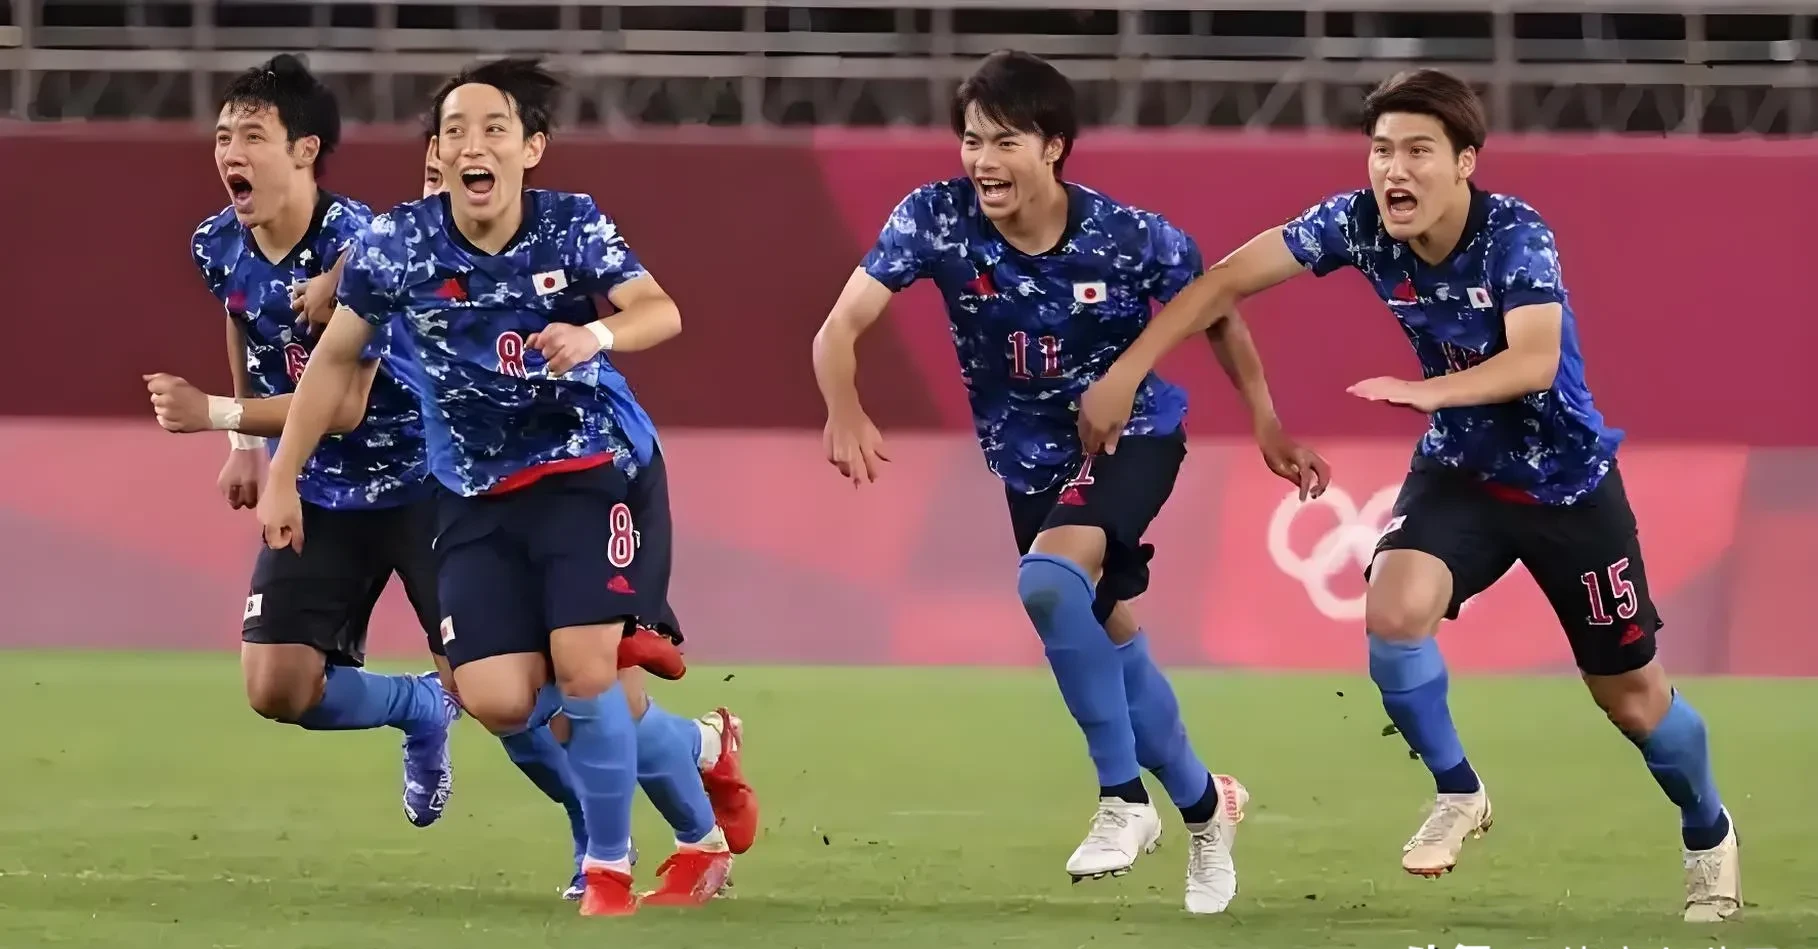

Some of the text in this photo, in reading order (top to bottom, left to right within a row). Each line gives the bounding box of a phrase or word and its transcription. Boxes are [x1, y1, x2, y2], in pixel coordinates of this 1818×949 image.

[496, 331, 528, 380] 8
[1008, 331, 1064, 380] 11
[607, 502, 635, 568] 8
[1581, 557, 1639, 626] 15
